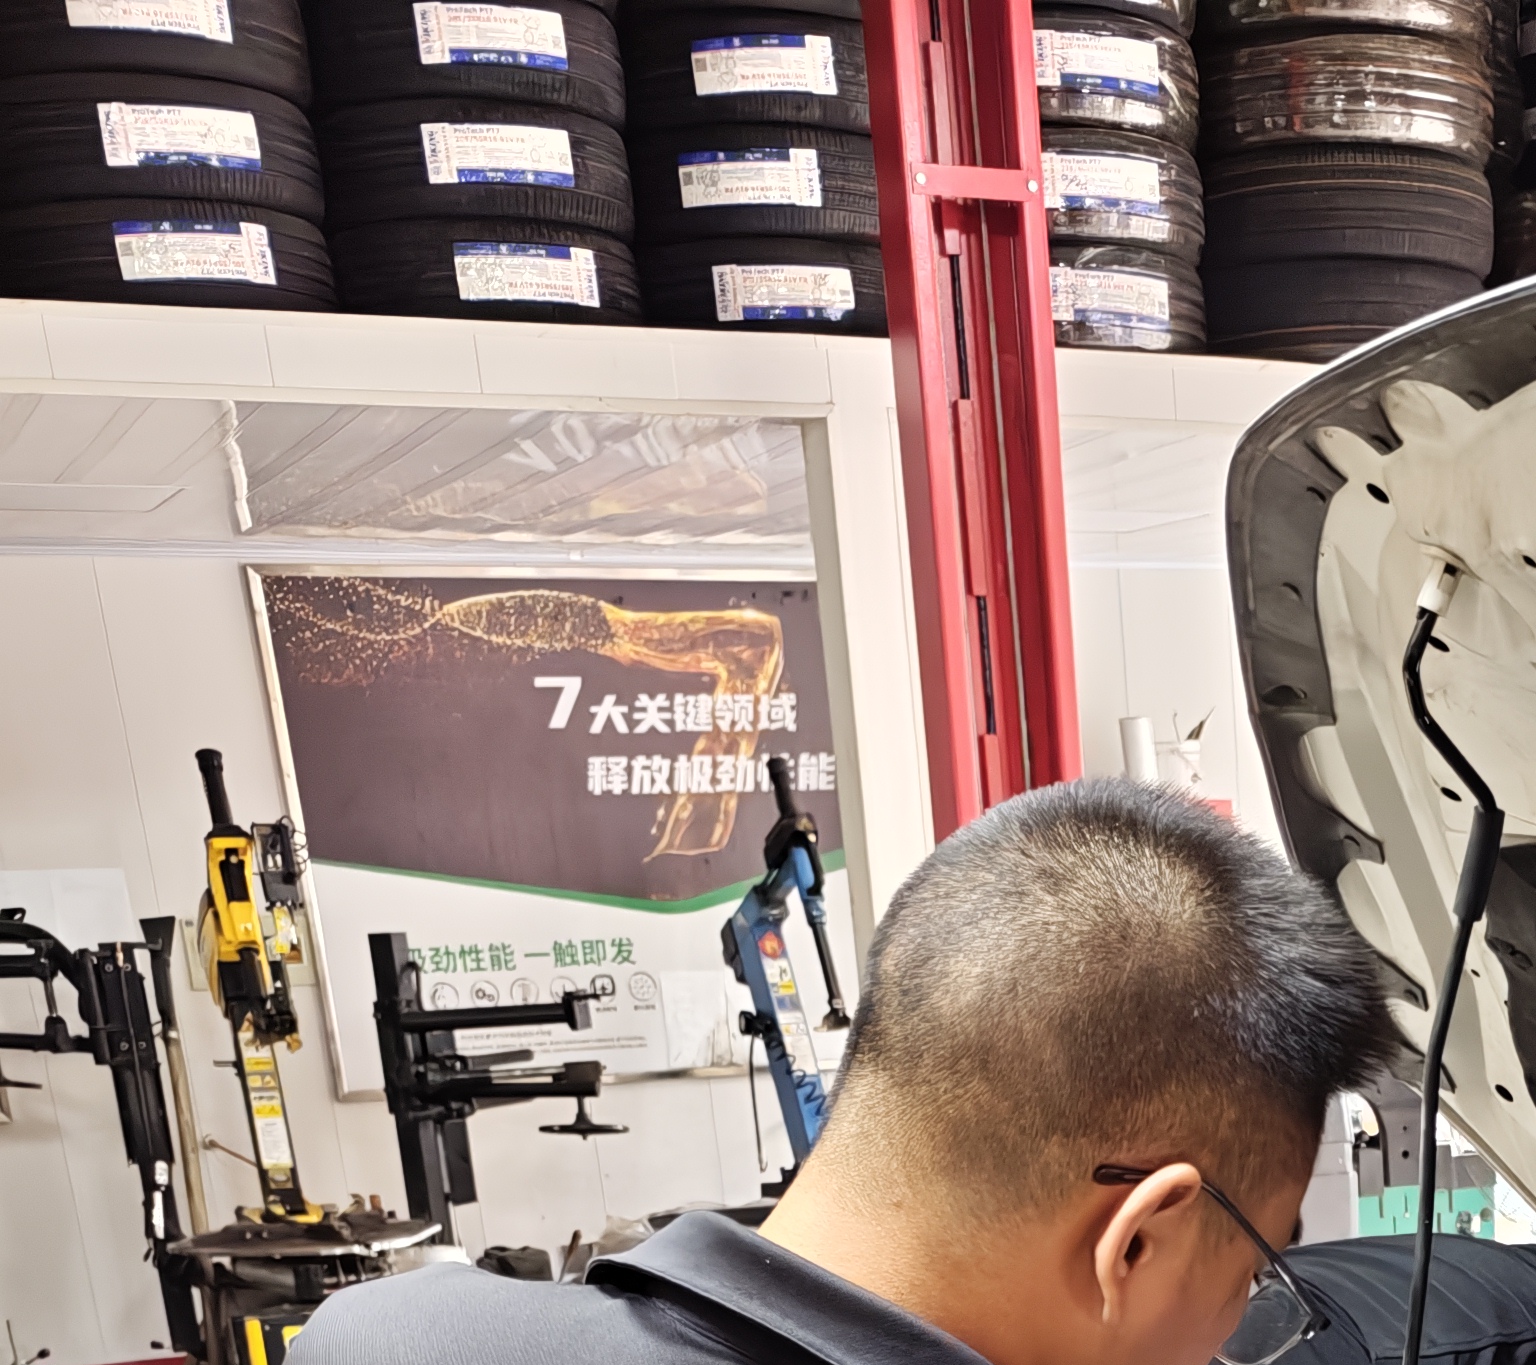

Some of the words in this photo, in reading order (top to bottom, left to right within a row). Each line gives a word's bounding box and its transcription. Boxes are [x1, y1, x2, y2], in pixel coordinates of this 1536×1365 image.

[533, 676, 797, 734] 7大关键领域
[523, 937, 637, 968] 一触即发
